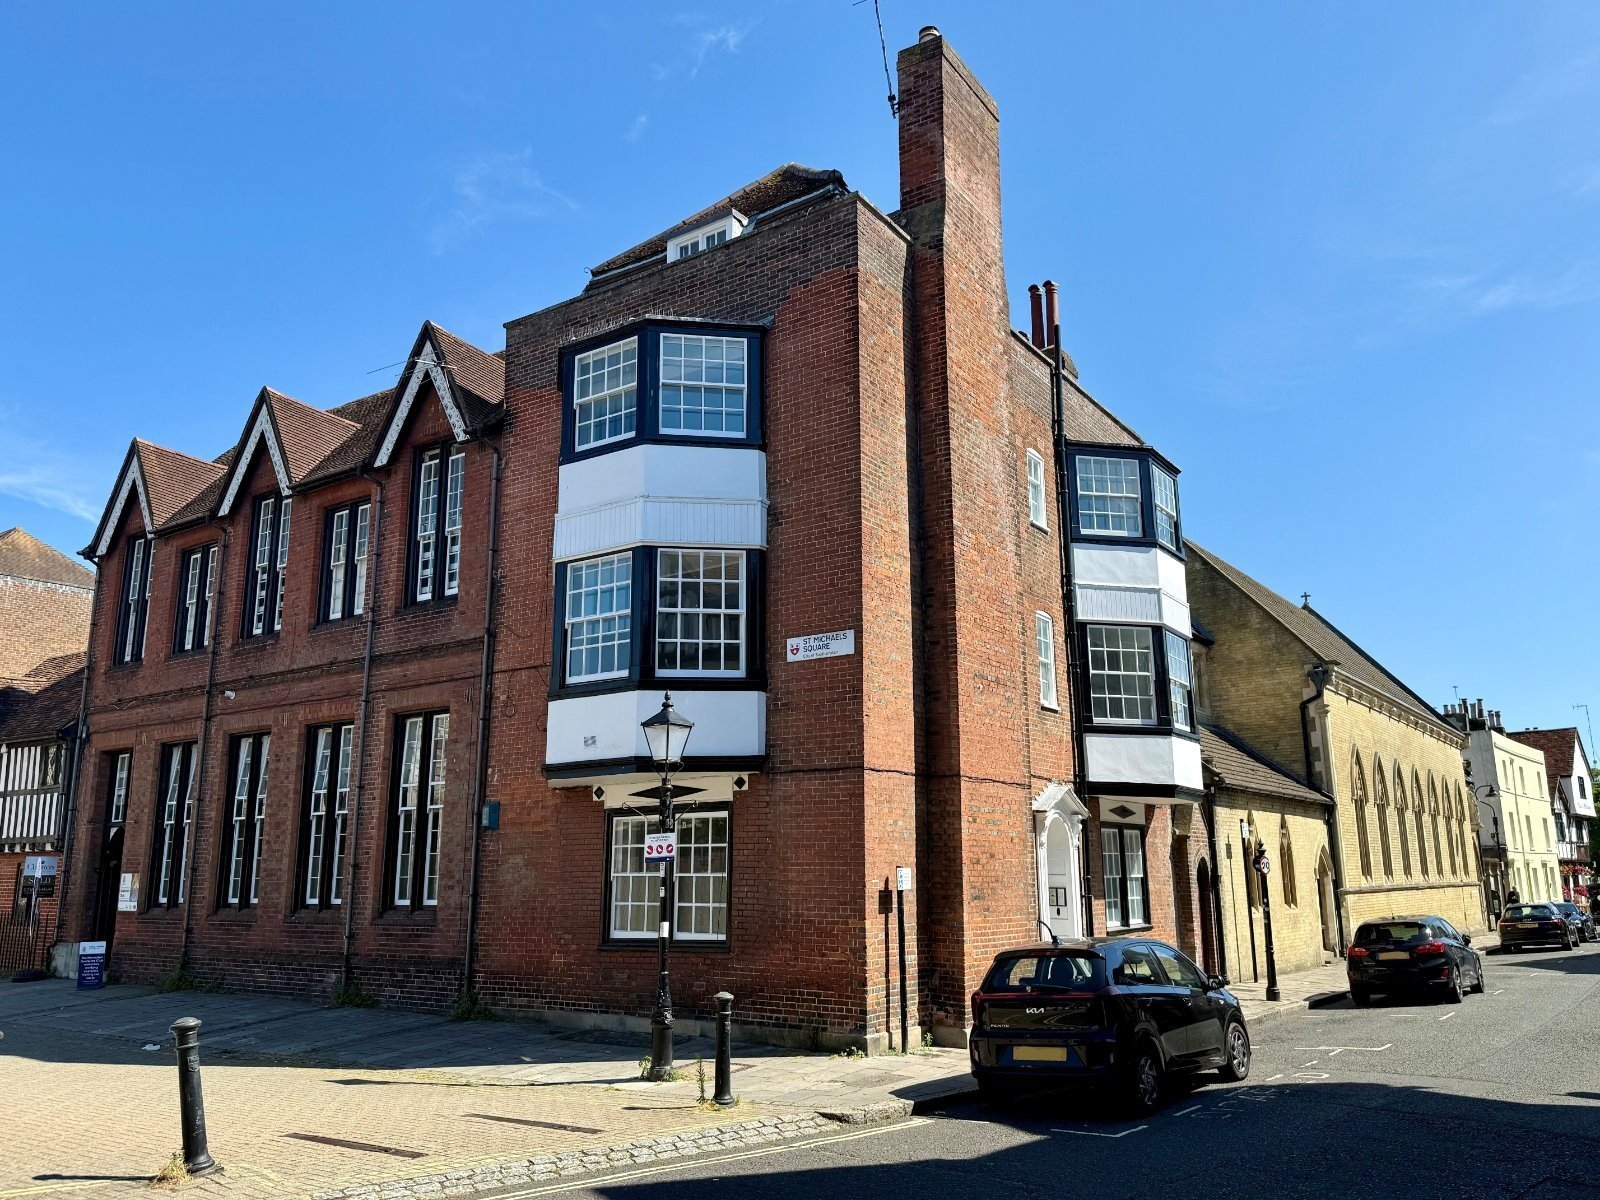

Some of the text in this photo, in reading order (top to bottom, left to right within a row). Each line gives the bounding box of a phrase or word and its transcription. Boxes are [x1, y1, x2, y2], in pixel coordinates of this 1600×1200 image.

[803, 633, 847, 645] ST MICHAELS
[803, 643, 830, 652] SQUARE
